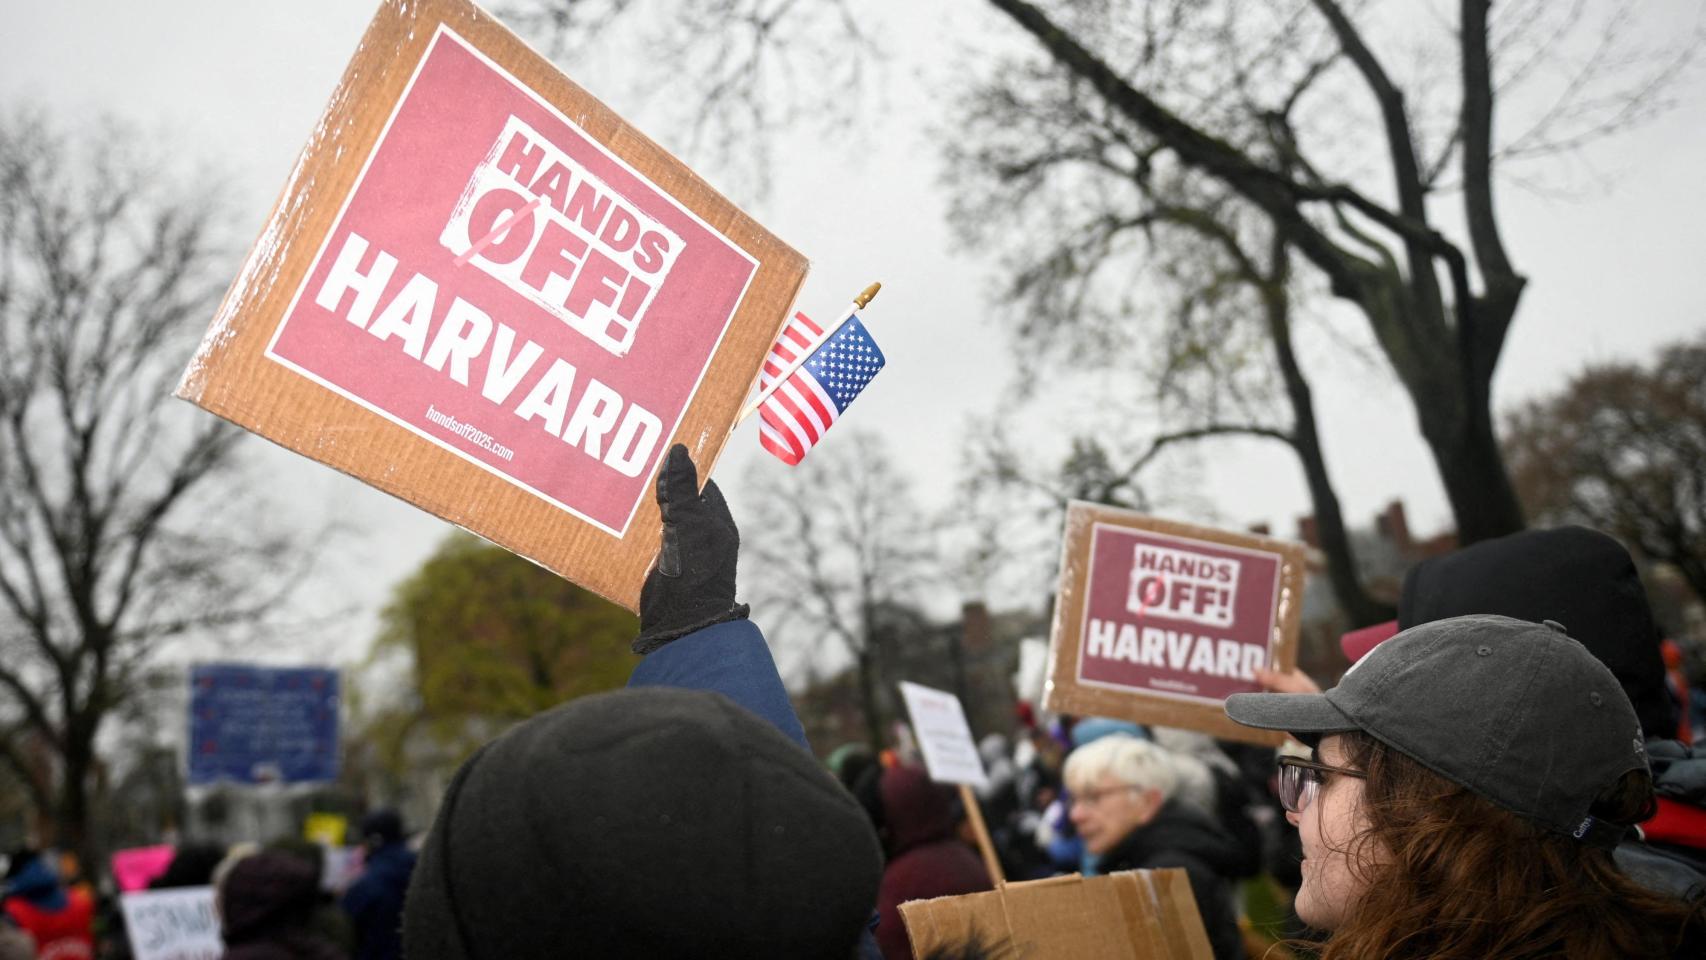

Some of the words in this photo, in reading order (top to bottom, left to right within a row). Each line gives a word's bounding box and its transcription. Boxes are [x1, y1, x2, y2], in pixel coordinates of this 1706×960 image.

[496, 130, 670, 274] HANDS
[467, 188, 651, 343] OFF!
[315, 231, 663, 478] HARVARD
[425, 404, 515, 461] handsoff2025.com
[1137, 576, 1231, 620] OFF!
[1140, 551, 1232, 583] HANDS
[1086, 618, 1266, 682] HARVARD
